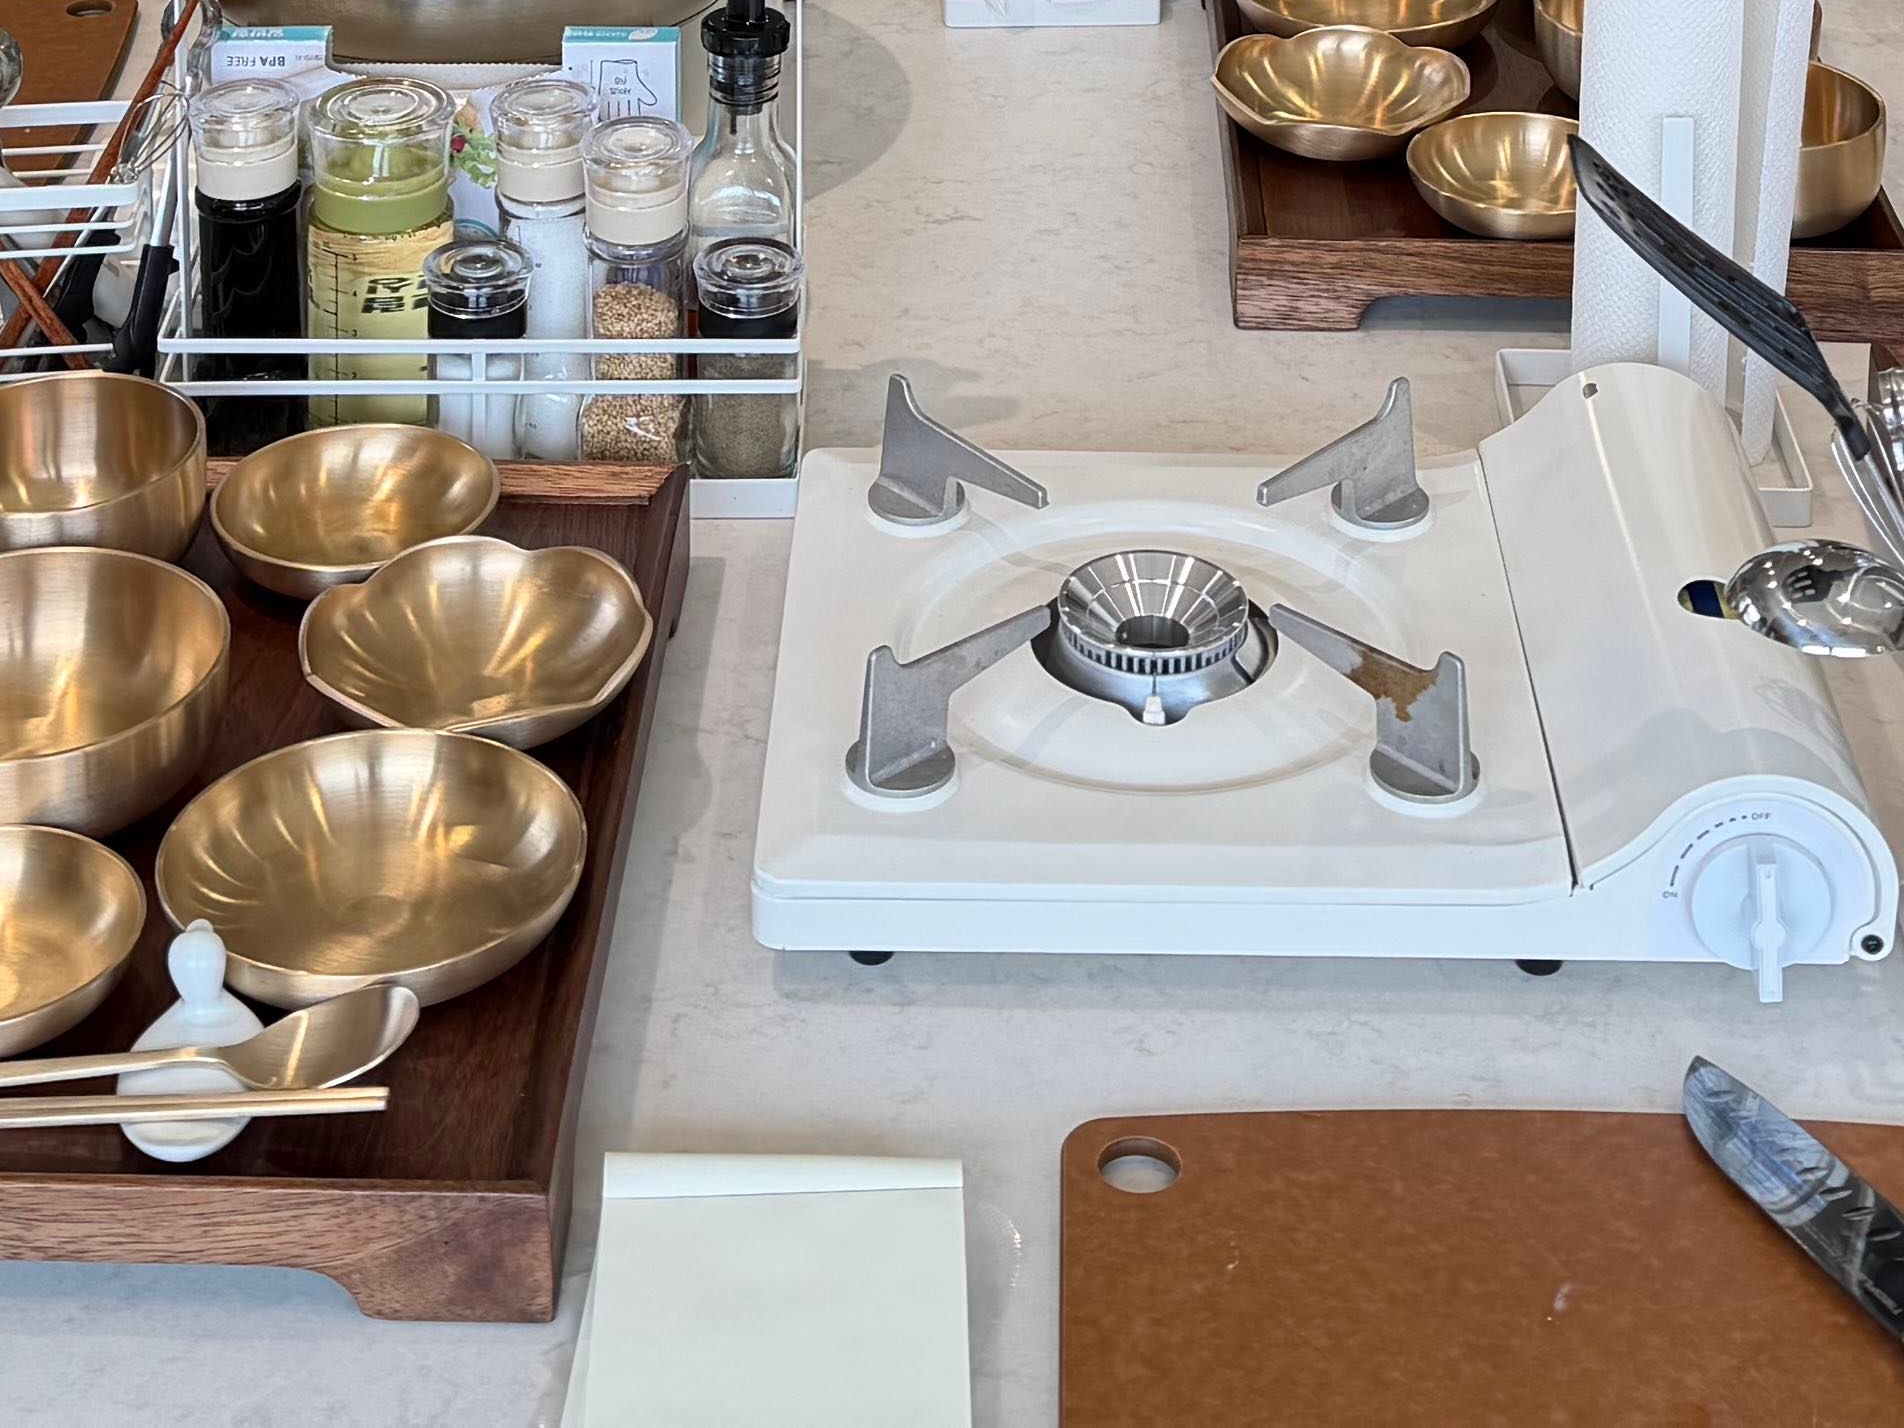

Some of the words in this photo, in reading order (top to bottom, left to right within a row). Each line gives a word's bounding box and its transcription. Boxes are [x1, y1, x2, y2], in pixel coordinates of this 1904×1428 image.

[226, 55, 256, 67] FREE
[260, 55, 286, 67] BPA
[1750, 812, 1772, 821] OFF
